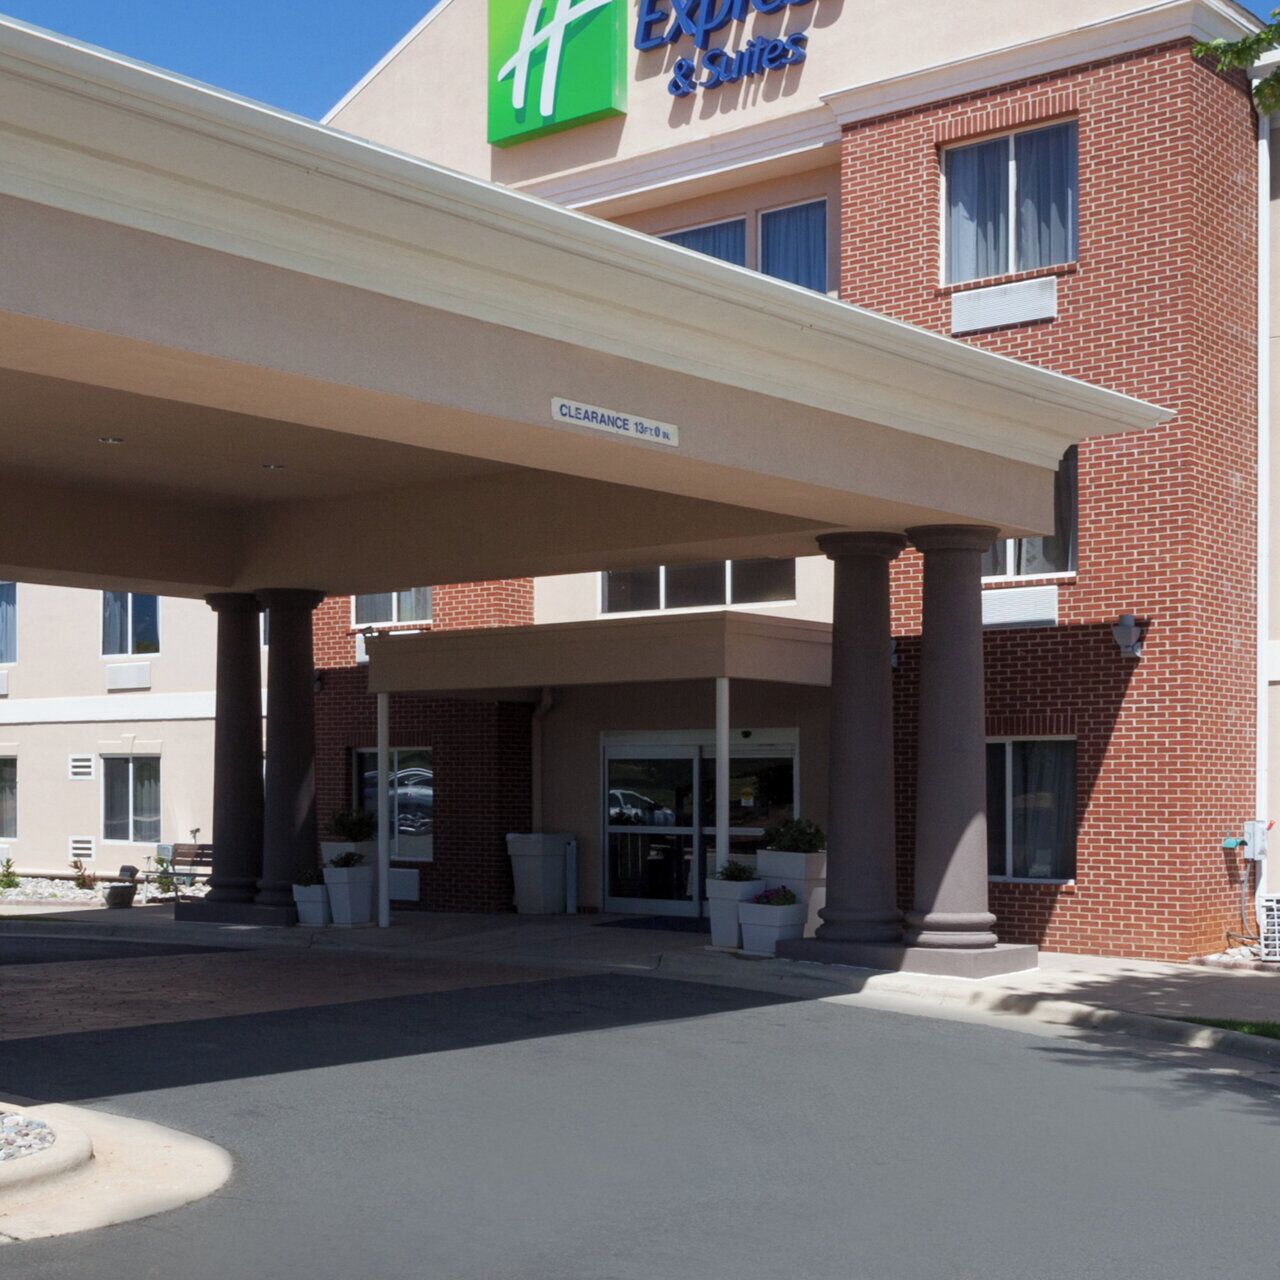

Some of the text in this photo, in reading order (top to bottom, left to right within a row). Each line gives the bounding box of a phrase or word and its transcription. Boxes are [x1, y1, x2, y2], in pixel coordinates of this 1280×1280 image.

[668, 32, 808, 97] & Suites
[559, 403, 630, 431] CLEARANCE
